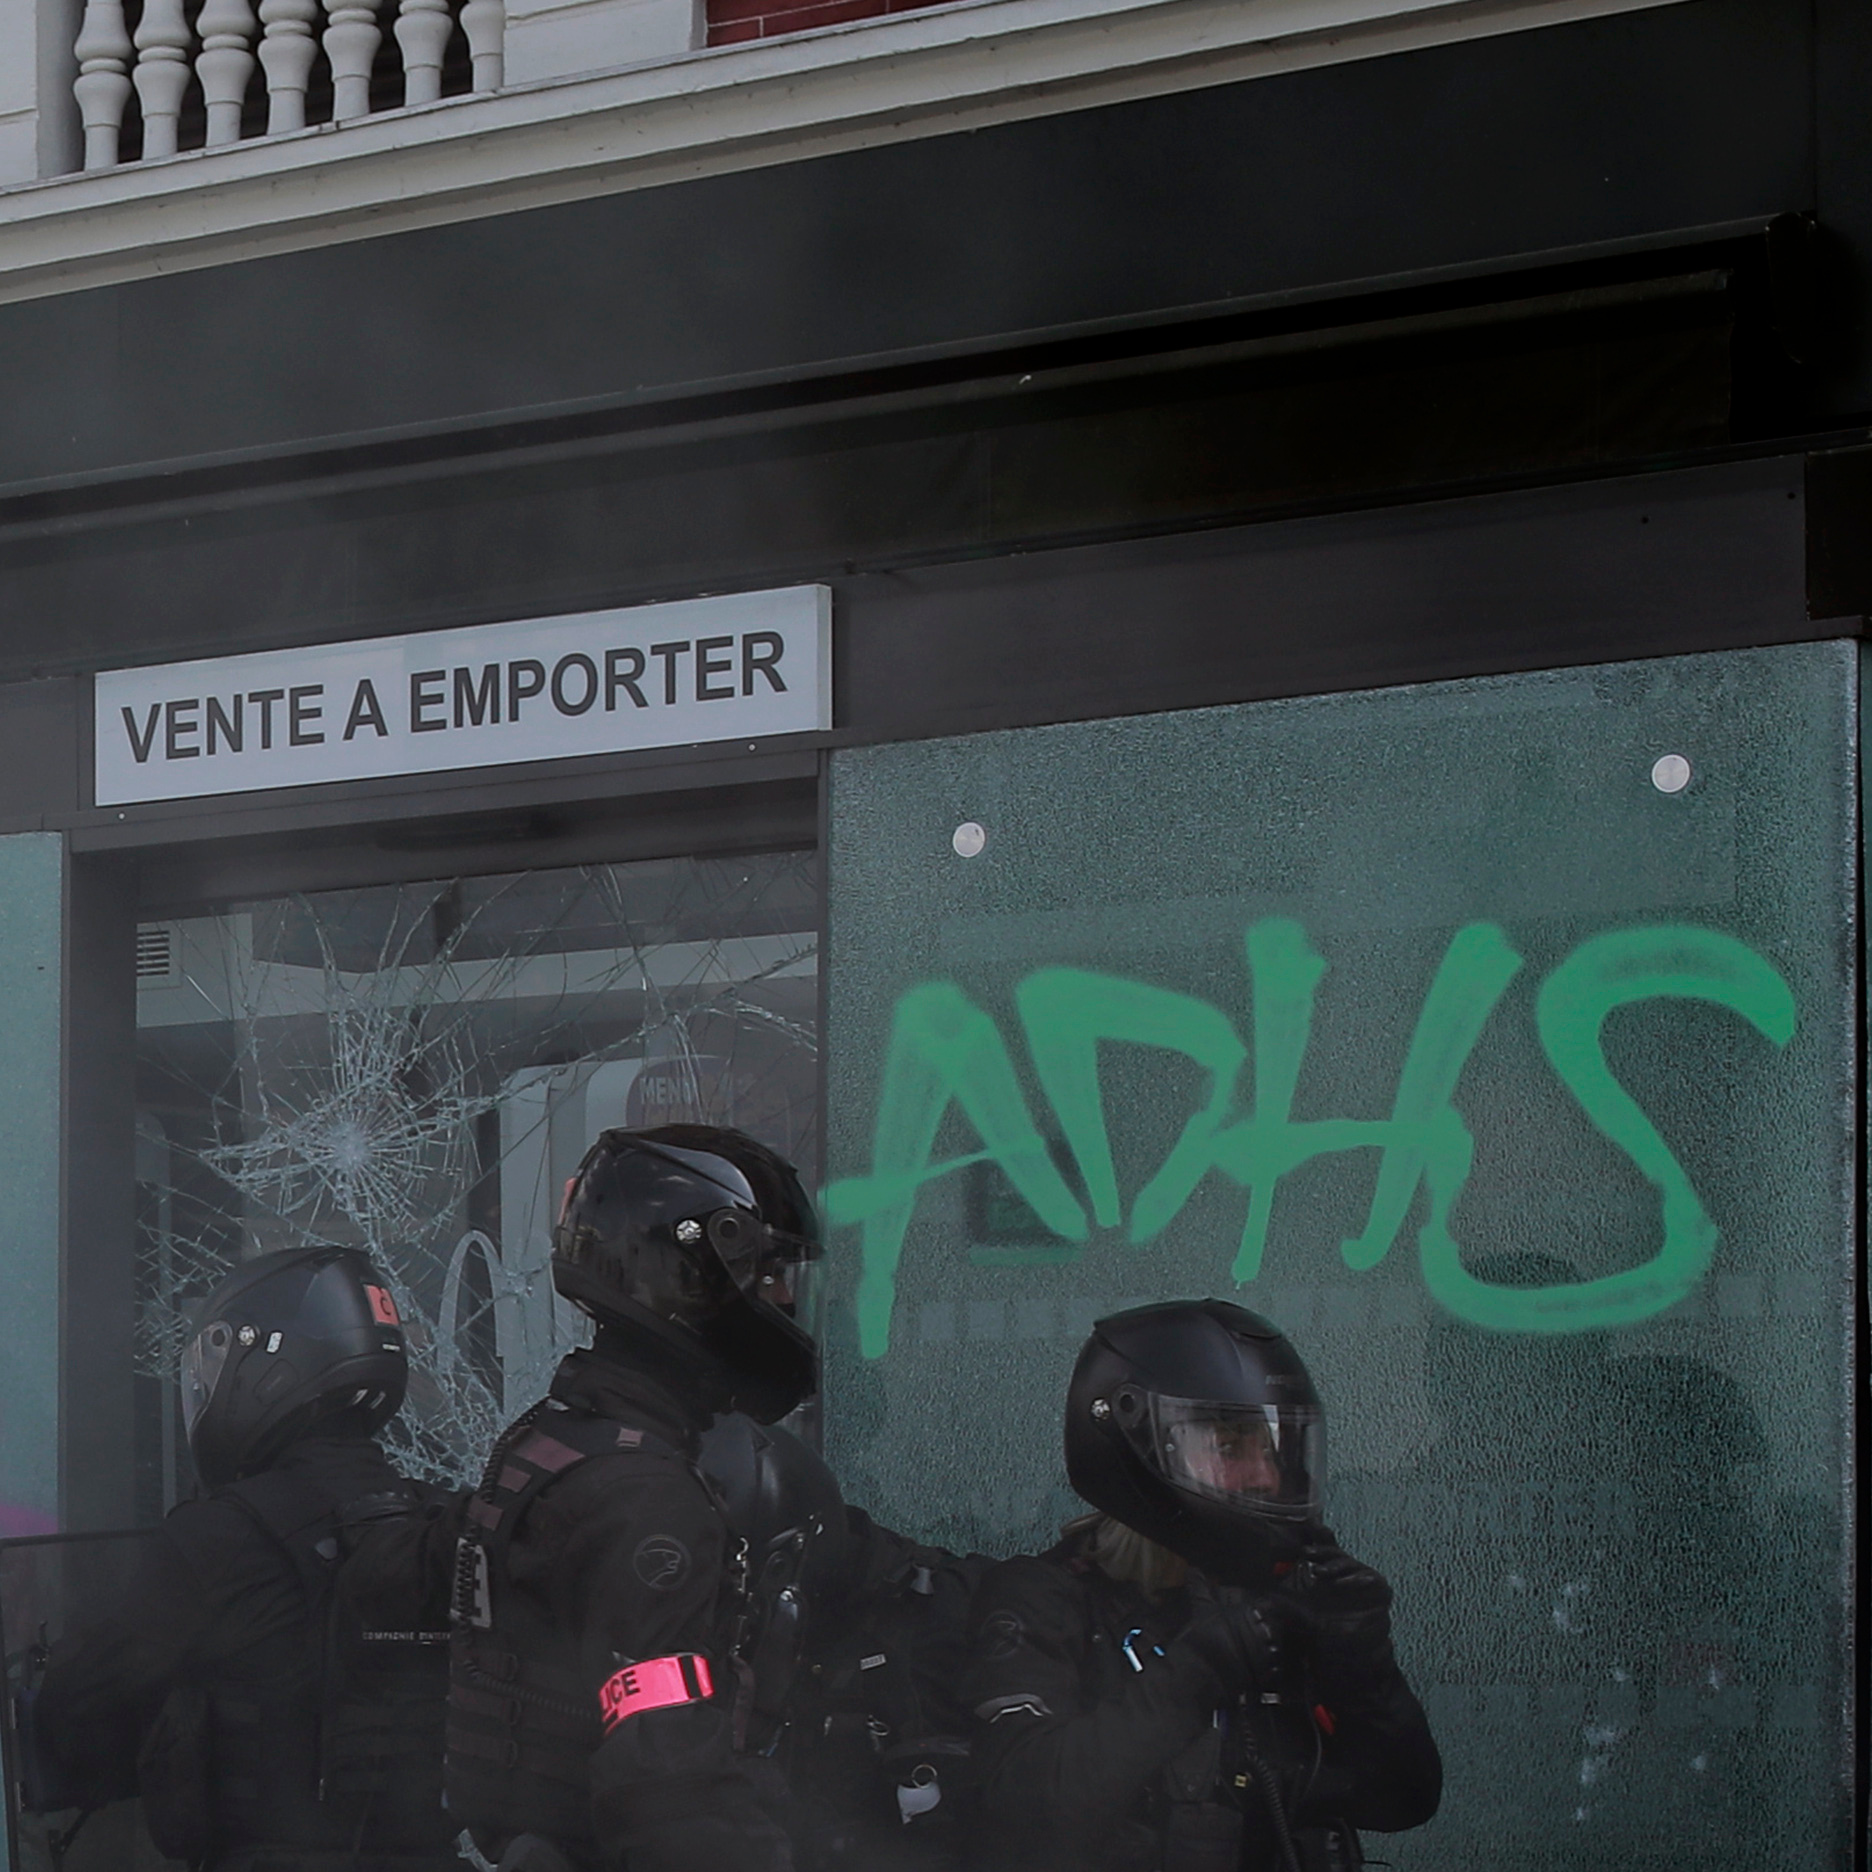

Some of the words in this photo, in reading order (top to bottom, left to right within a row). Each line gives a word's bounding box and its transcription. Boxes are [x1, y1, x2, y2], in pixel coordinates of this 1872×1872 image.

[121, 683, 325, 764] VENTE
[342, 678, 389, 741] A
[409, 630, 789, 734] EMPORTER
[818, 916, 1796, 1360] ADHS
